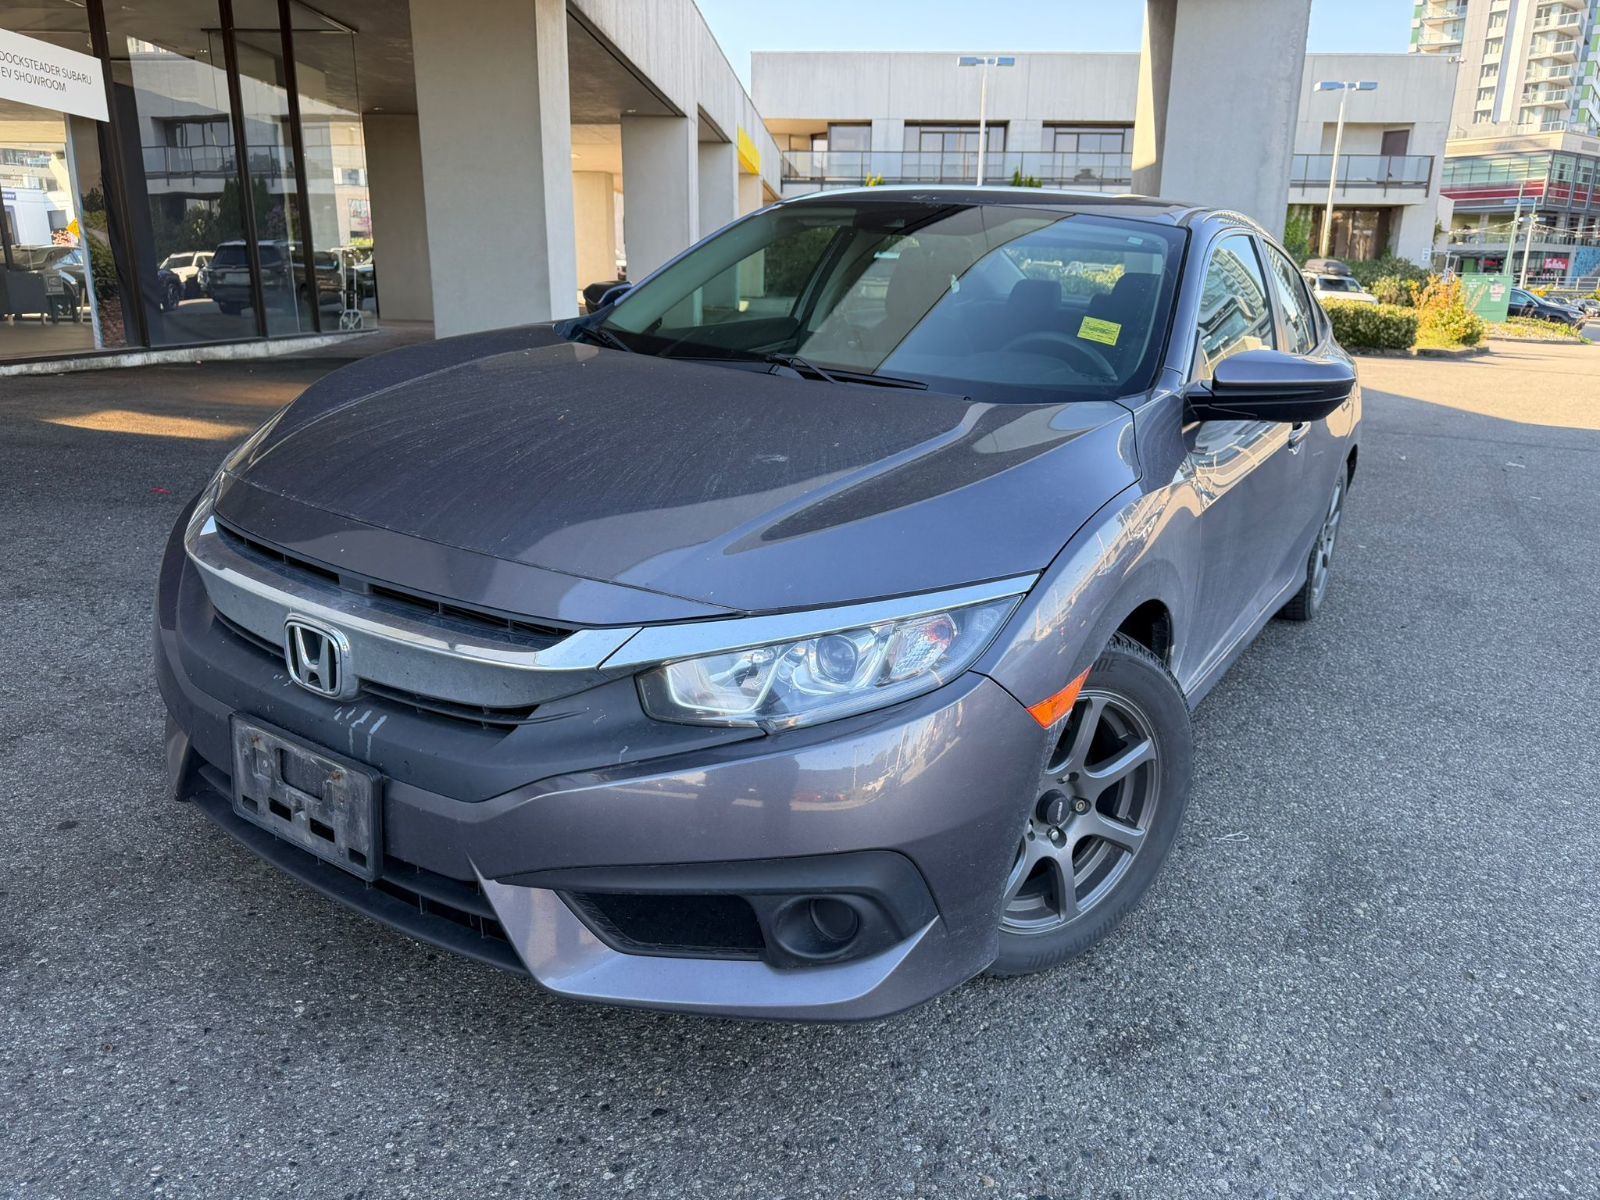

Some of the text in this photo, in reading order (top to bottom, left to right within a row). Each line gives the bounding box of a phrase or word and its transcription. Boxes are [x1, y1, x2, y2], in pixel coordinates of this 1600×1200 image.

[0, 50, 92, 85] DOCKSTEADER SUBARU
[1, 67, 67, 92] EV SHOWROOM
